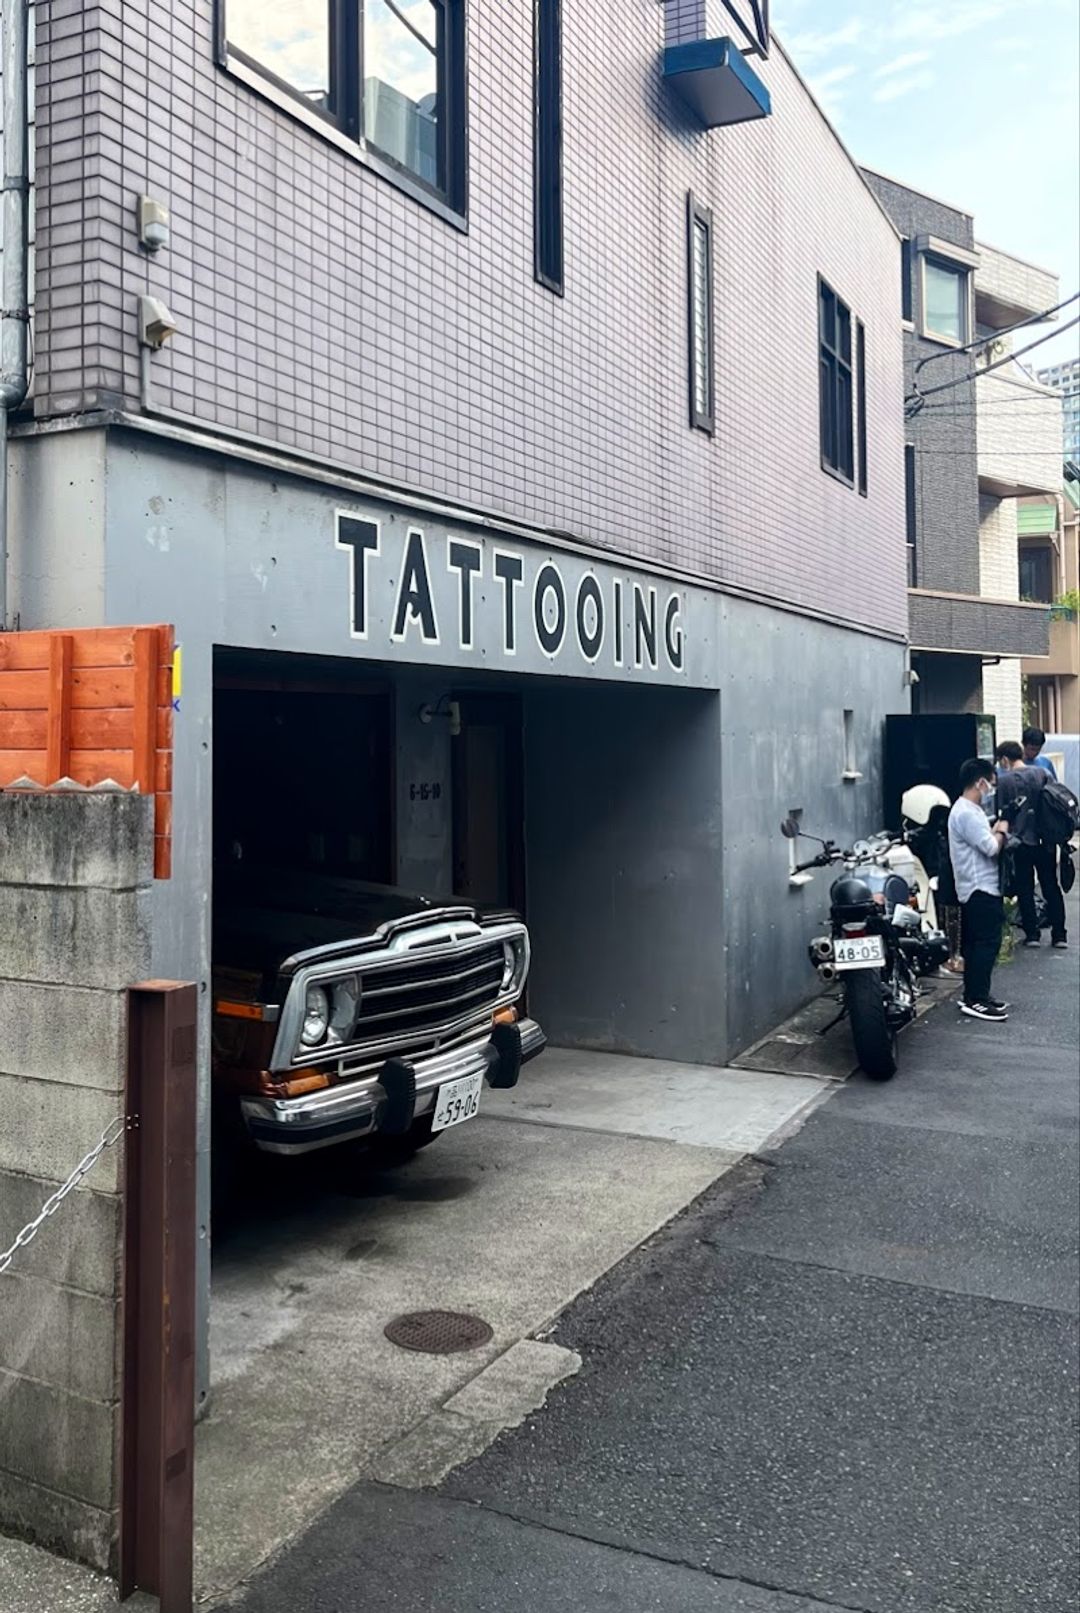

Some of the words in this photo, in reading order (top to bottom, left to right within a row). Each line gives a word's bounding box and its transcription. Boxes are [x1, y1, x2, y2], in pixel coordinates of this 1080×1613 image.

[335, 508, 685, 674] TATTOOING
[838, 945, 880, 960] 48-05
[445, 1090, 479, 1125] 59-06
